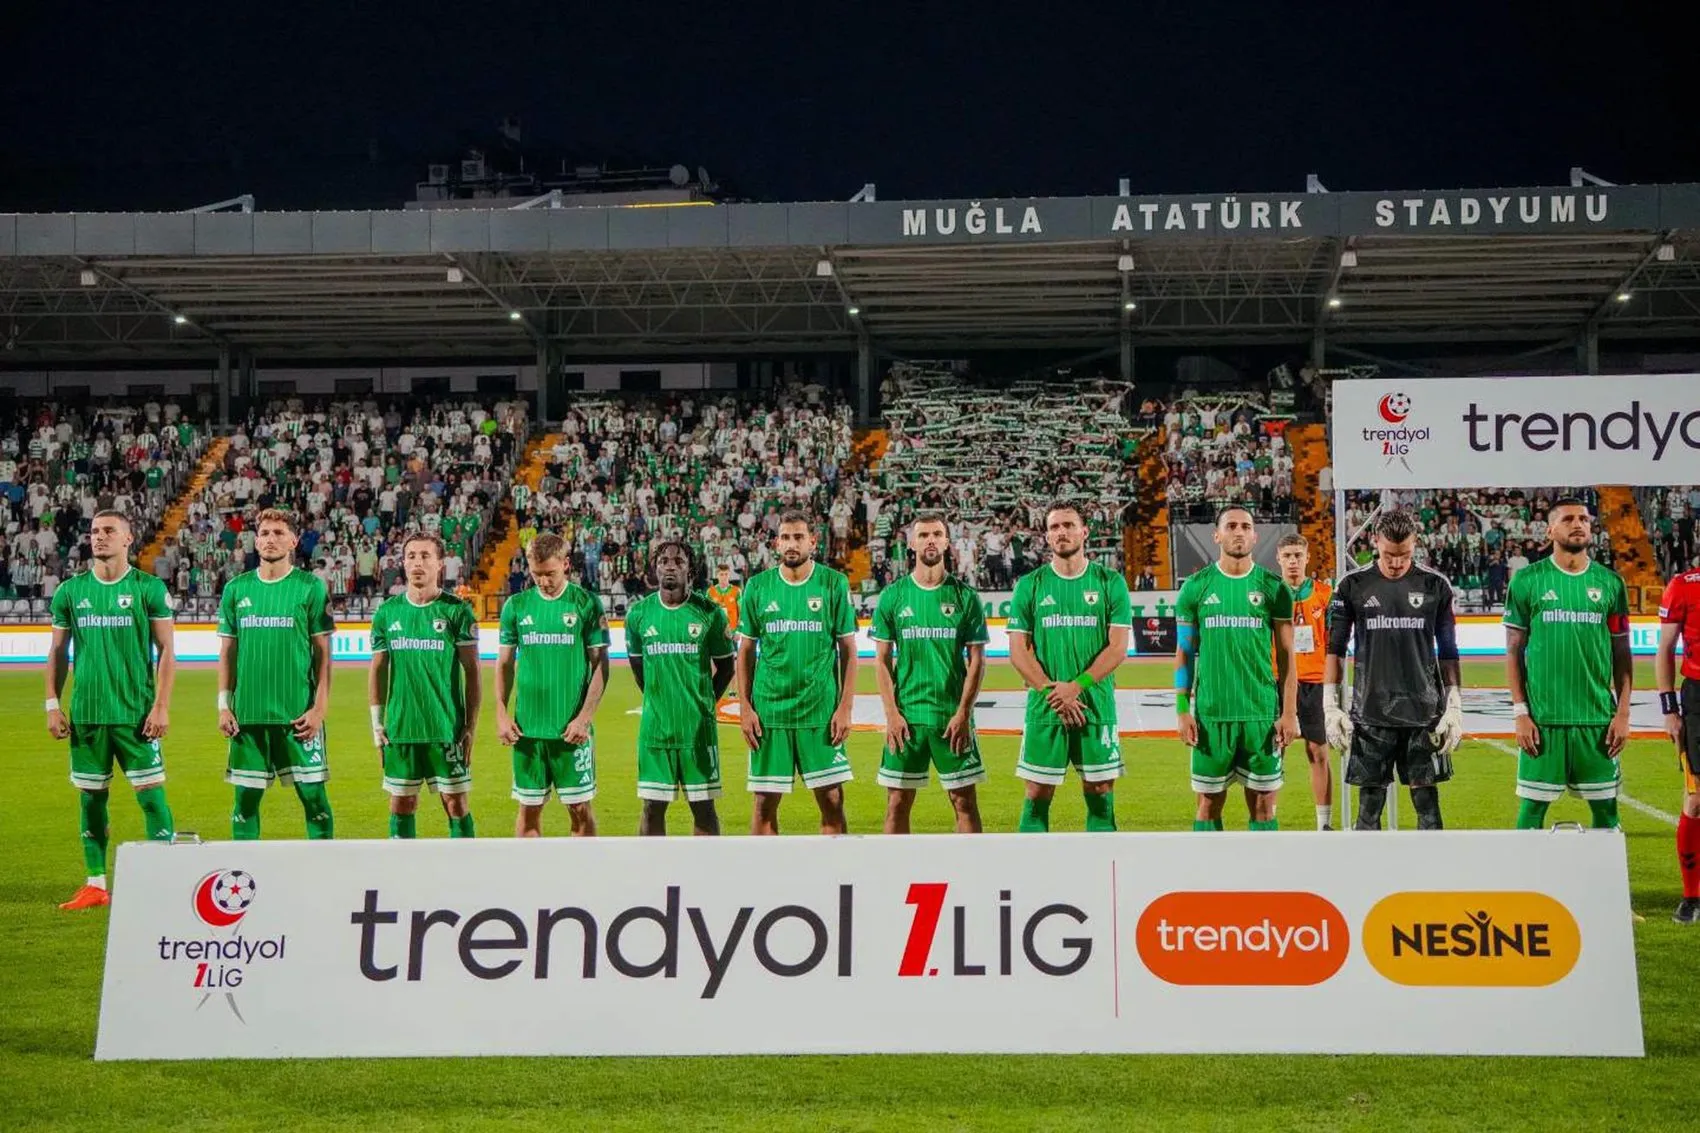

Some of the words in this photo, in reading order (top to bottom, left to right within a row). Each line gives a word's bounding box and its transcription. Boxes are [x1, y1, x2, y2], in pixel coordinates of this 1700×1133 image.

[903, 201, 1042, 236] MUĞLA
[1111, 195, 1303, 232] ATATÜRK
[1375, 194, 1608, 227] STADYUMU
[1362, 427, 1430, 443] trendyol
[78, 614, 132, 628] mikroman
[241, 614, 294, 628] mikroman
[1043, 613, 1097, 628] mikroman
[1206, 614, 1262, 628] mikroman
[1367, 614, 1424, 629] mikroman
[1543, 608, 1602, 624] mikroman
[766, 619, 822, 633] mikroman
[902, 625, 957, 639] mikroman
[391, 636, 445, 651] mikroman
[522, 632, 575, 646] mikroman
[647, 641, 699, 656] mikroman
[350, 884, 854, 1000] trendyol
[1157, 918, 1329, 960] trendyol
[158, 934, 286, 965] trendyol
